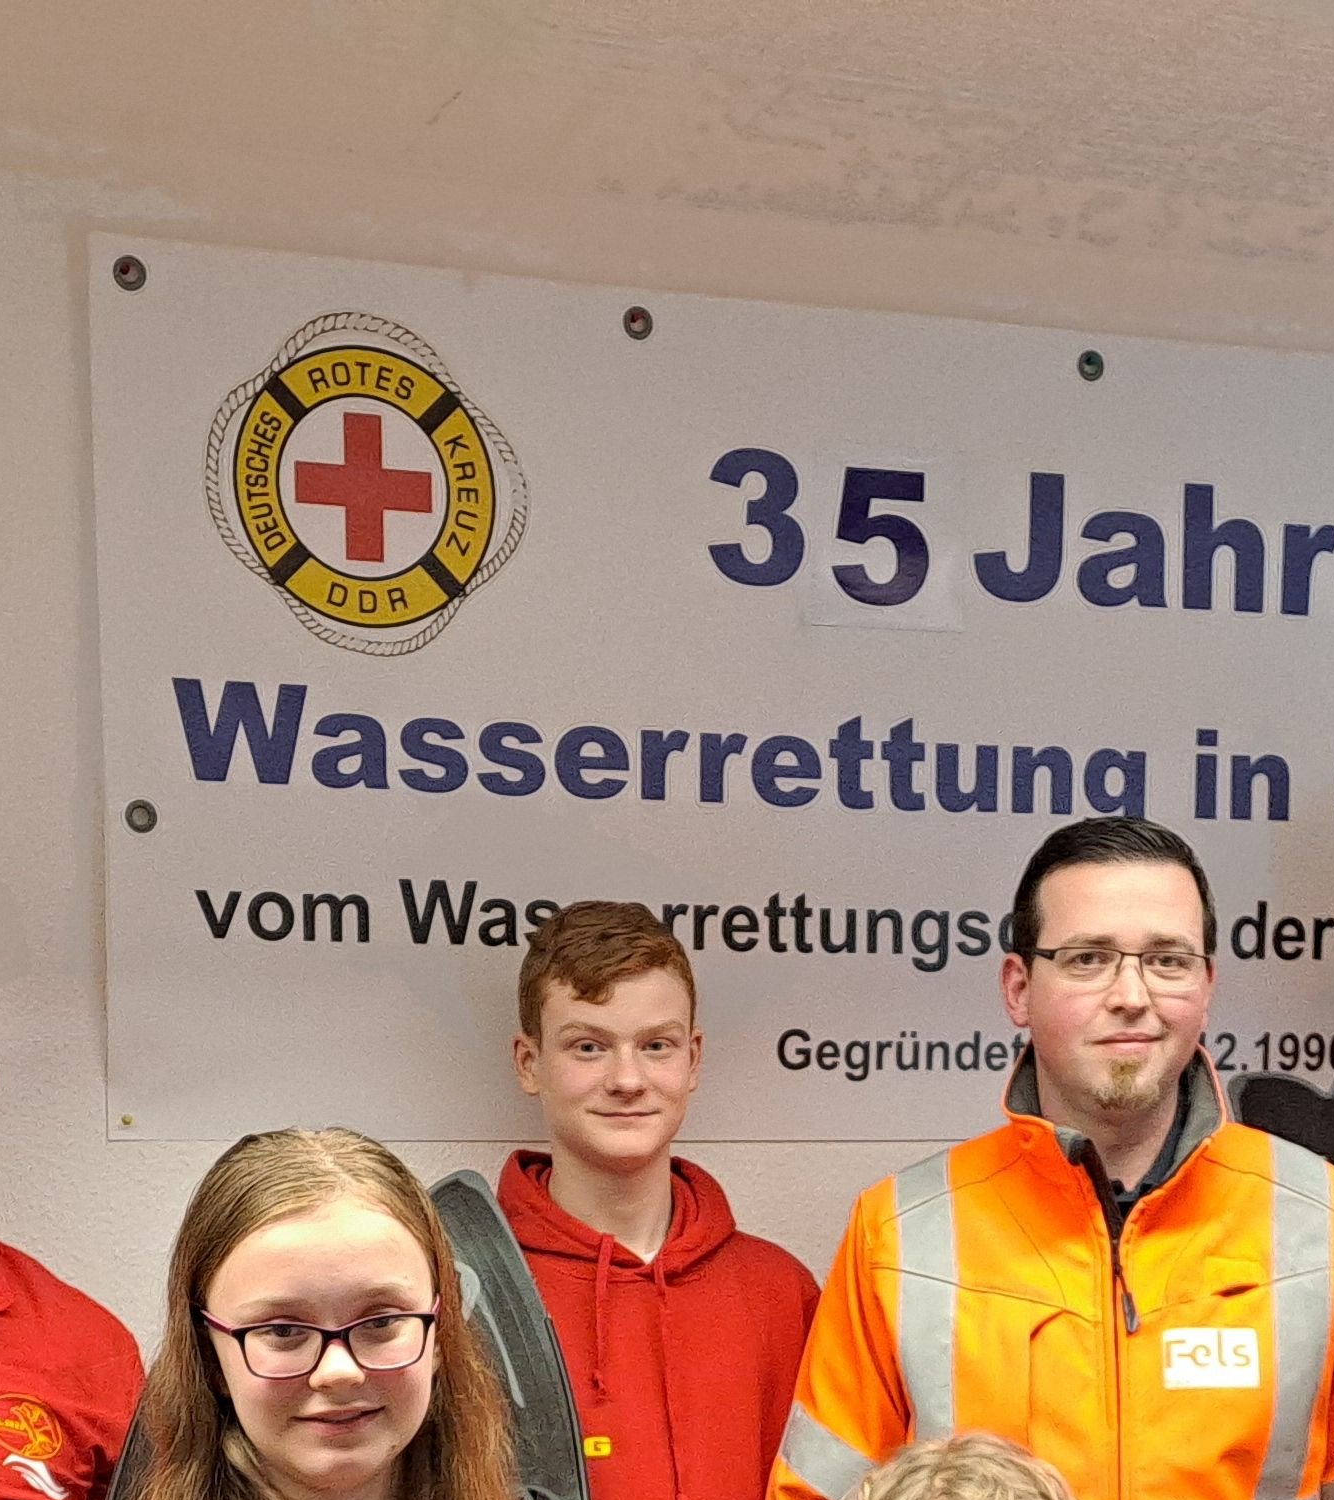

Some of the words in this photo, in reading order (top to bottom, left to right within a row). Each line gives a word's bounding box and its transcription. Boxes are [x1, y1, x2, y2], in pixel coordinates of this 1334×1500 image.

[244, 410, 288, 552] DEUTSCHES
[307, 360, 416, 401] ROTES
[444, 433, 480, 558] KREUZ
[706, 446, 931, 607] 35
[325, 582, 409, 614] DDR
[170, 676, 1147, 820] Wasserrettung
[1193, 727, 1292, 822] in
[193, 887, 372, 944] vom
[776, 1028, 1027, 1083] Gegründet
[1164, 1329, 1252, 1370] Fels
